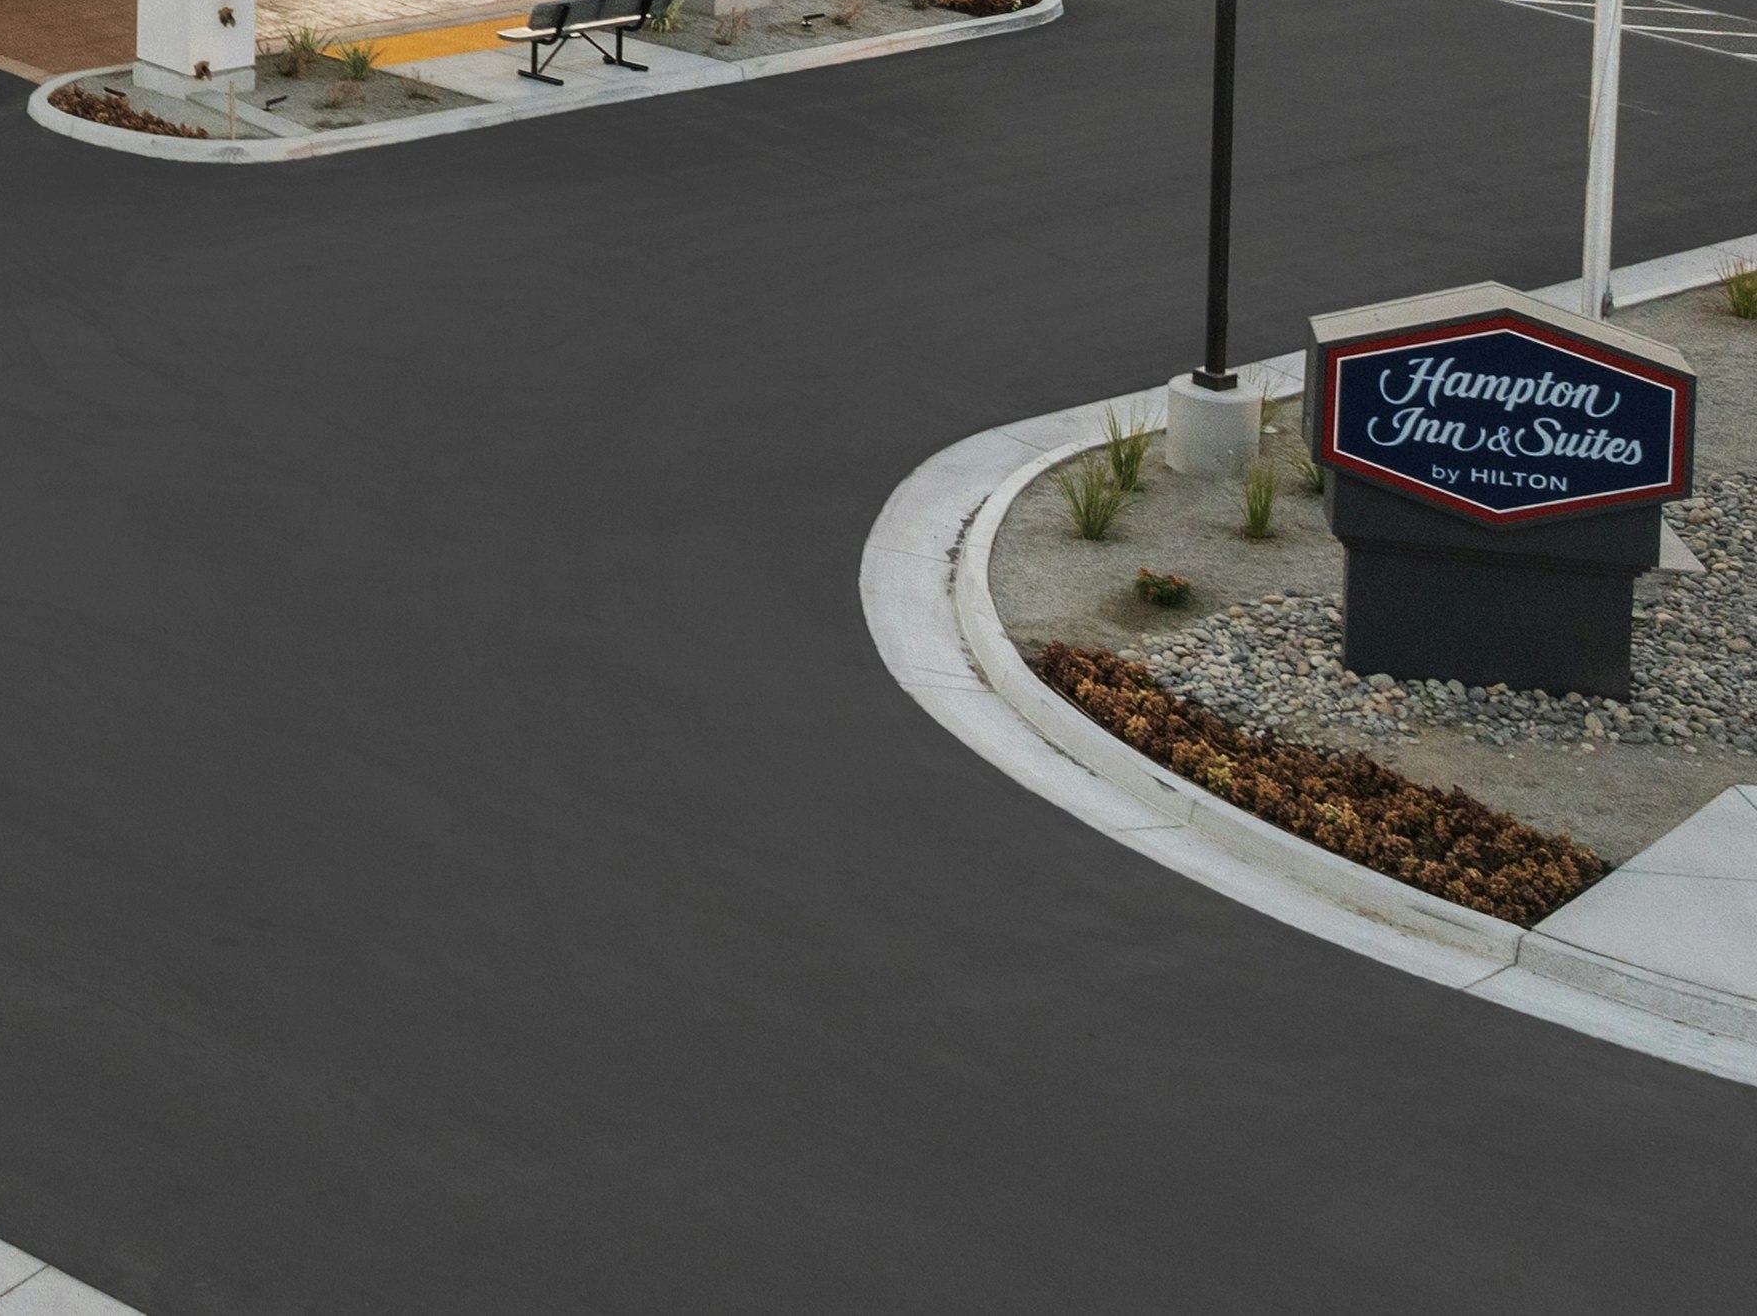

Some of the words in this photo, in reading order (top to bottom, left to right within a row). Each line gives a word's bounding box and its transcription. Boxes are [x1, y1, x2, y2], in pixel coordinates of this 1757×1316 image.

[1379, 357, 1621, 418] Hampton
[1367, 407, 1486, 452] Inn
[1486, 425, 1518, 458] &
[1513, 417, 1644, 466] Suites
[1431, 464, 1461, 484] by
[1470, 467, 1569, 492] HILTON
